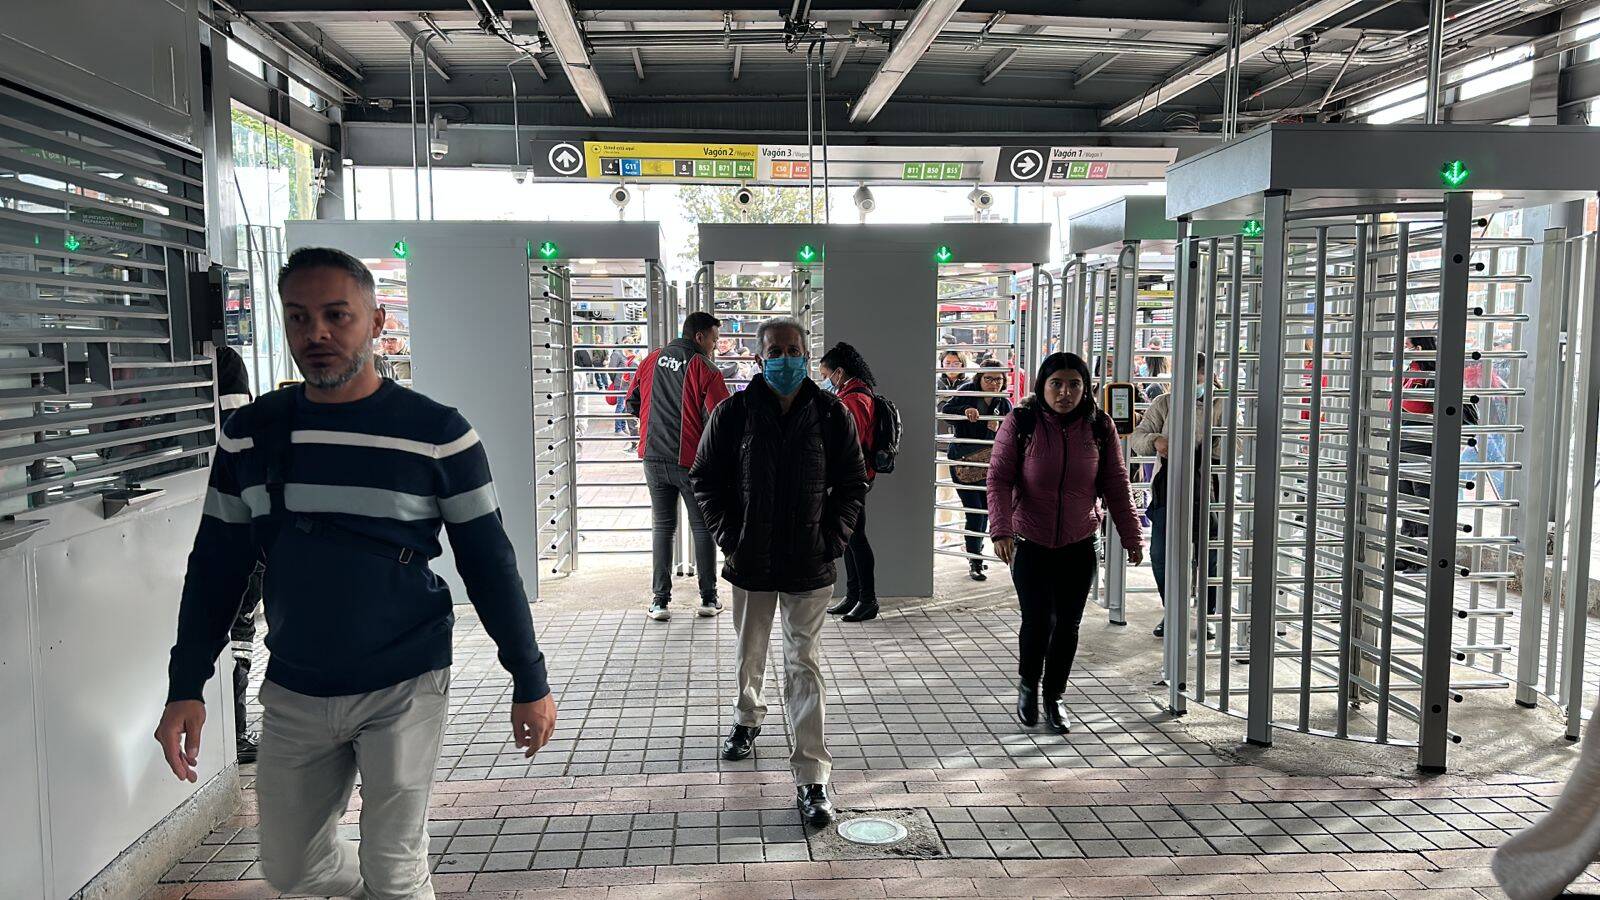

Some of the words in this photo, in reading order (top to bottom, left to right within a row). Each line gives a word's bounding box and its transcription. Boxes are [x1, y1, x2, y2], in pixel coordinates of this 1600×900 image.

[703, 148, 727, 157] Vagón
[762, 148, 785, 158] Vagón
[1054, 149, 1076, 159] Vagón
